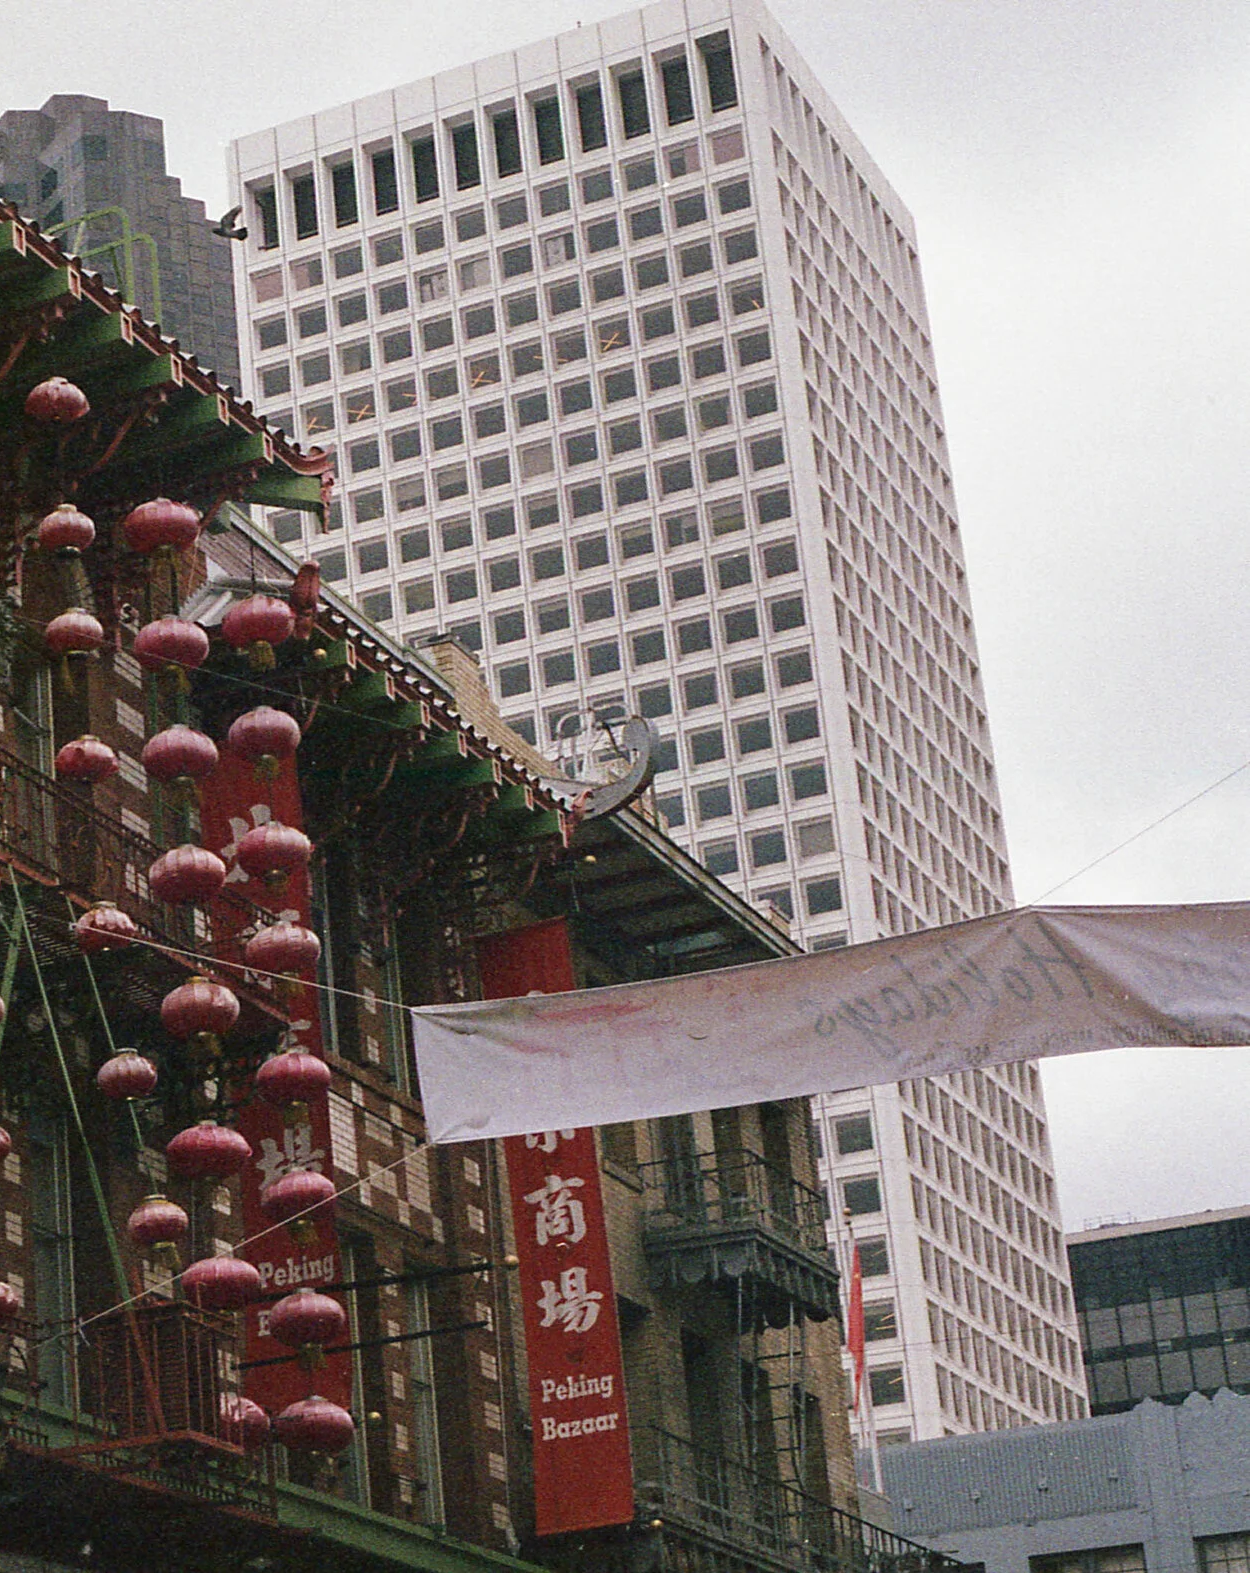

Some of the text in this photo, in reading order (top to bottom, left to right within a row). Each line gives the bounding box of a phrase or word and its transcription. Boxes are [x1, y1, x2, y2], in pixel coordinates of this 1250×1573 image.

[258, 1254, 334, 1289] Peking
[541, 1374, 613, 1403] Peking
[541, 1412, 618, 1441] Bazaar
